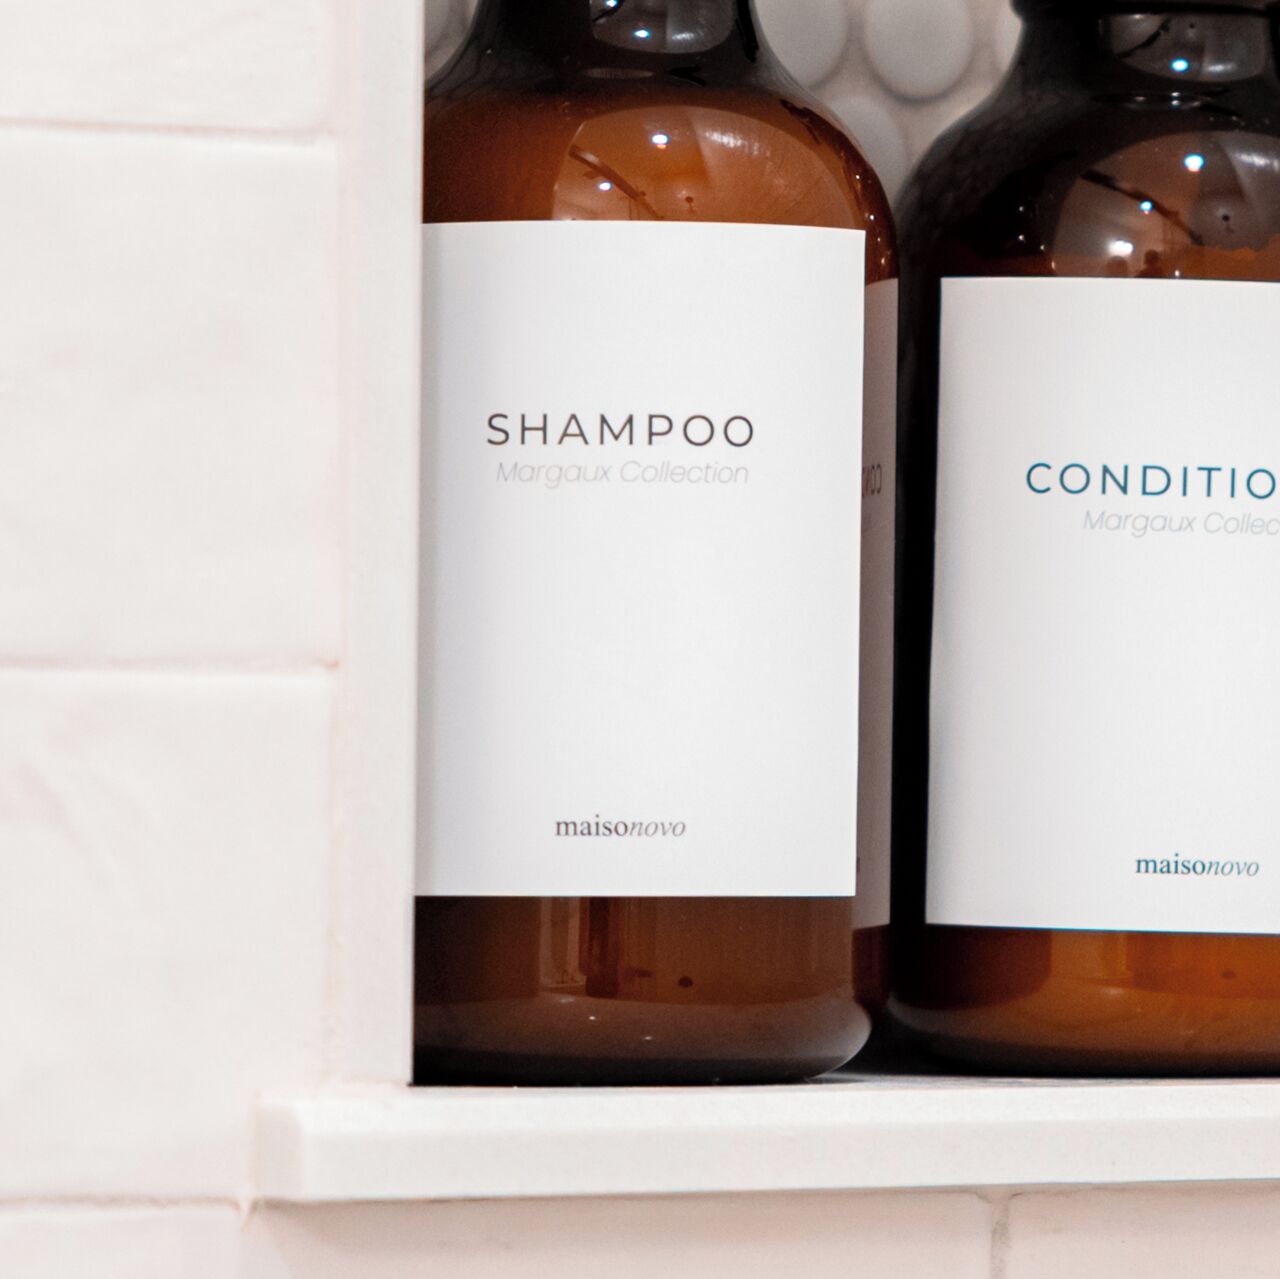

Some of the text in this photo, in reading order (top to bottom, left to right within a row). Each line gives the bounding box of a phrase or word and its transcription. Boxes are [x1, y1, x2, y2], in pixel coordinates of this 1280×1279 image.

[485, 412, 756, 448] SHAMPOO
[496, 459, 750, 490] Margaux Collection
[1082, 510, 1198, 539] Margaux
[553, 814, 687, 839] maisonovo
[1134, 851, 1261, 878] maisonovo
